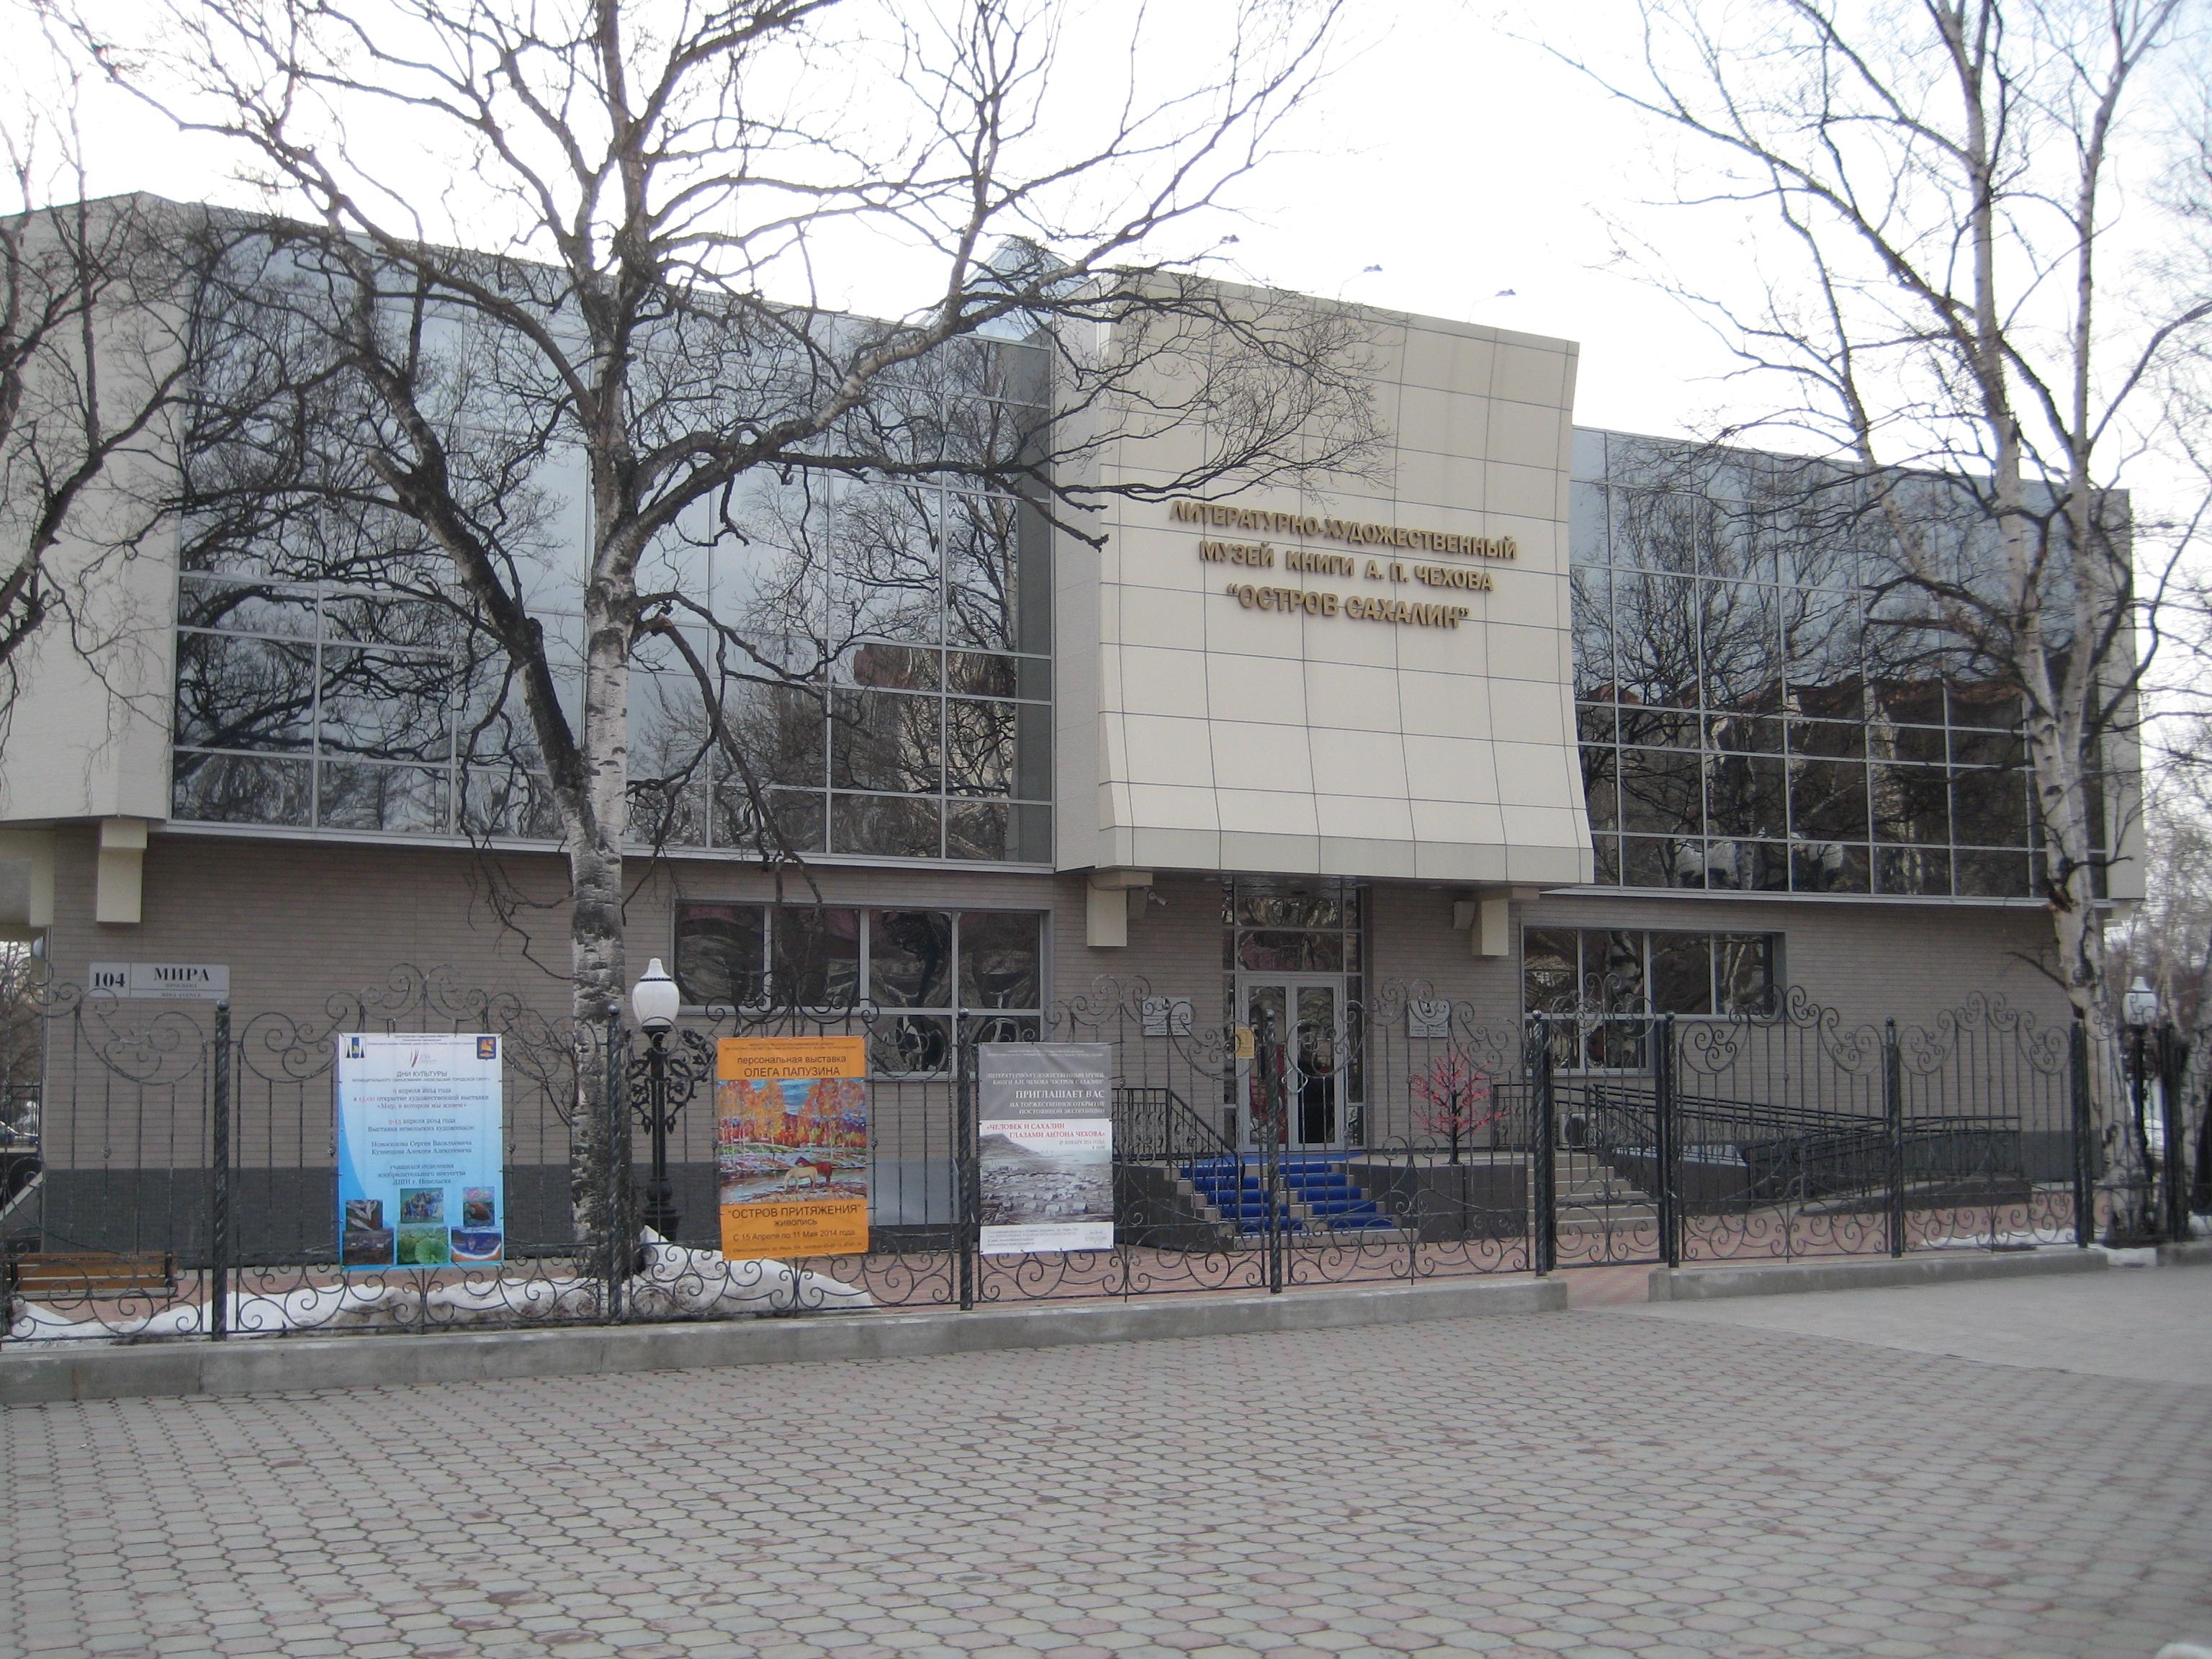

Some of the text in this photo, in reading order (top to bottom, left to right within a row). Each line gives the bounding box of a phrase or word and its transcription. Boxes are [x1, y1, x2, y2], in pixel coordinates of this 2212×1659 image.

[1169, 500, 1518, 559] ЛИТЕРАТУРНО-ХУДОЖЕСТВЕННЫЙ
[1200, 540, 1494, 591] МУЗЕЙ КНИГИ А. П. ЧЕХОВА
[95, 973, 125, 987] 104
[154, 968, 210, 981] МИРА
[745, 1066, 840, 1077] ОЛЕГА ПАПУЗИНА
[1015, 1090, 1083, 1099] ПРИГЛАШАЕТ
